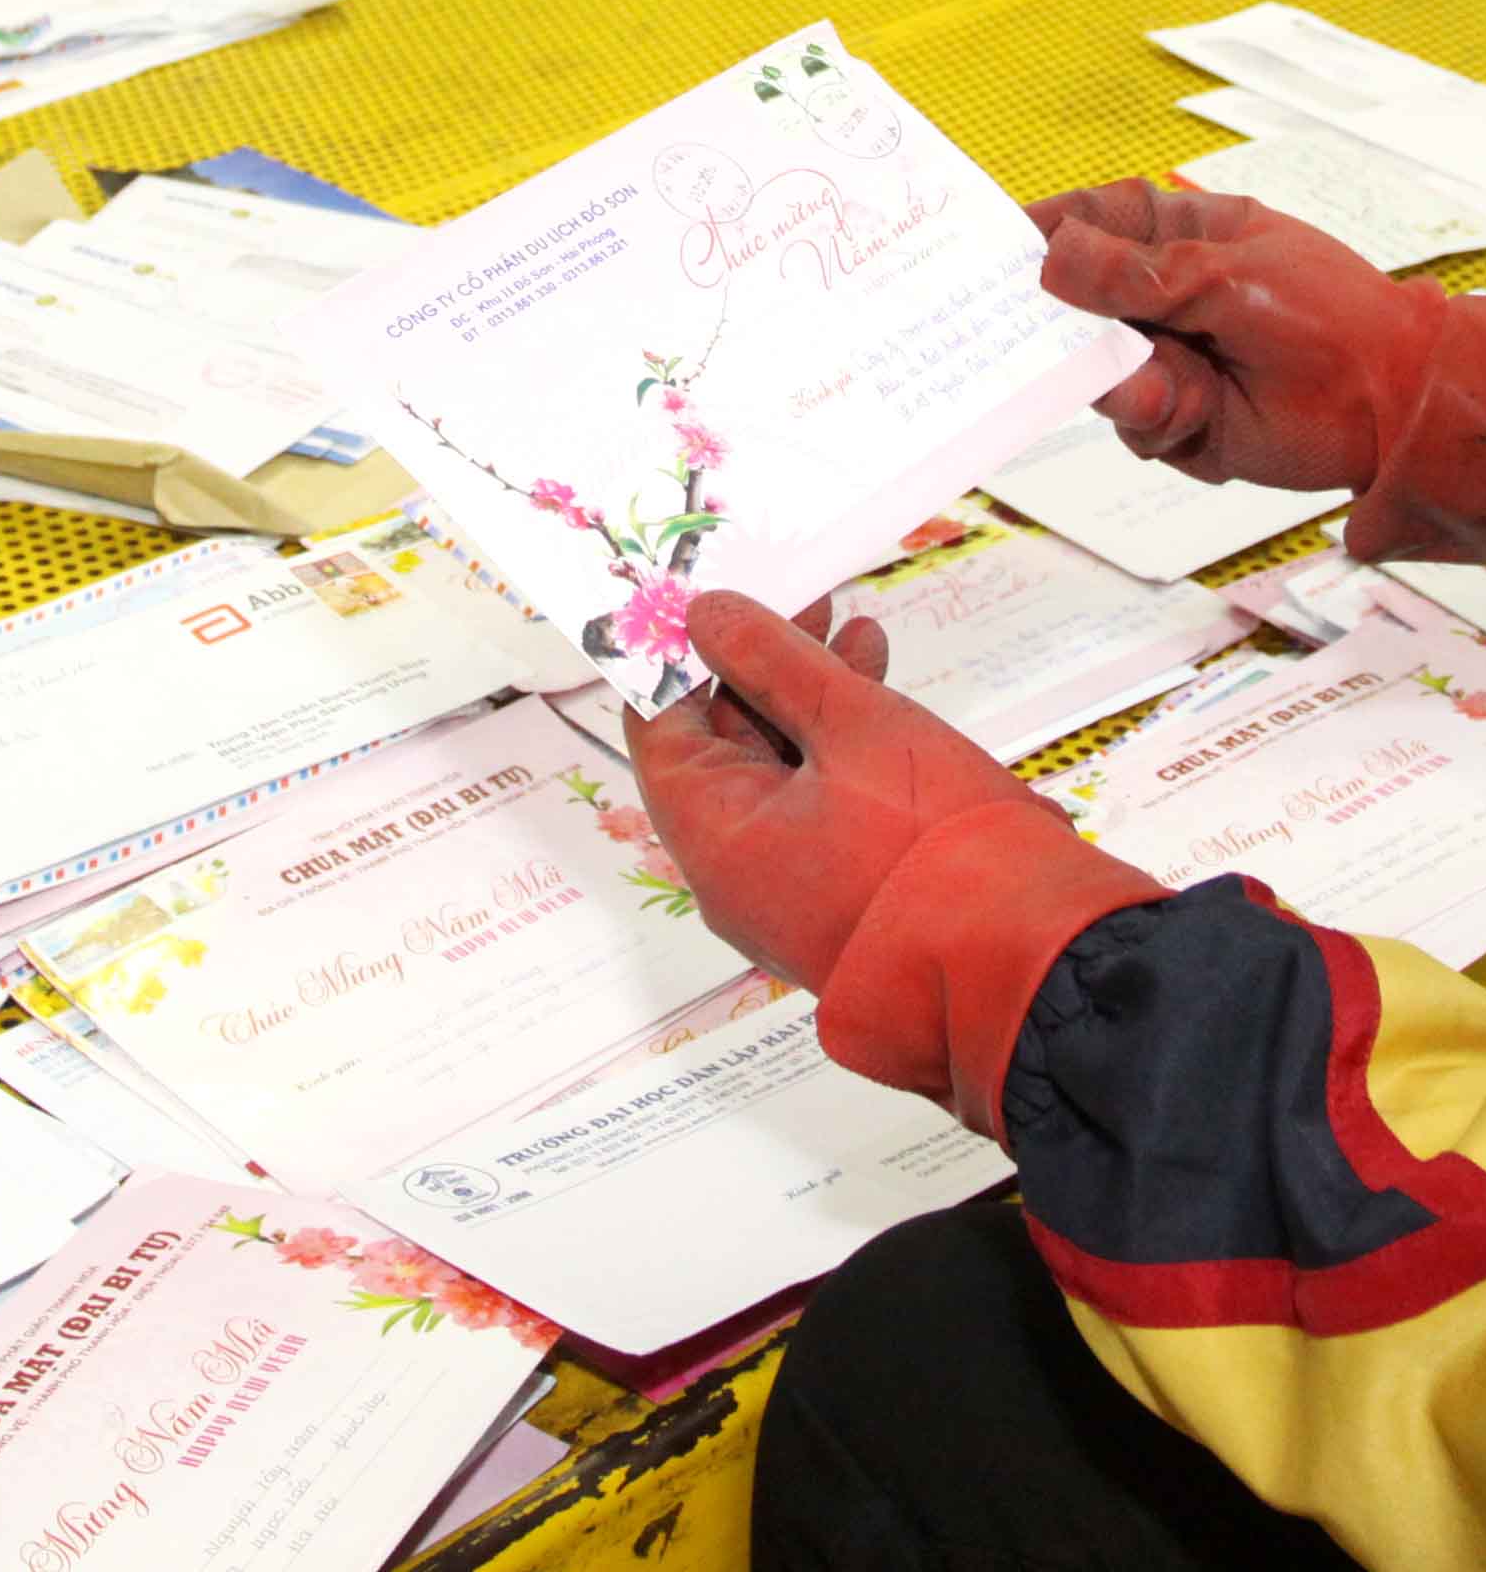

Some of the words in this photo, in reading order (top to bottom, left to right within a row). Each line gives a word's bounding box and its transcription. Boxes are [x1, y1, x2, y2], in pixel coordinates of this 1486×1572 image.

[386, 303, 438, 338] CÔNG
[436, 291, 456, 309] TY
[457, 271, 484, 296] CỔ
[525, 236, 549, 257] DU
[547, 217, 582, 244] LỊCH
[246, 583, 304, 611] Abb
[279, 848, 350, 885] CHÙA
[457, 783, 490, 807] BI
[401, 901, 491, 956] Năm
[496, 1120, 592, 1170] TRƯỜNG
[4, 1342, 66, 1397] MẬT
[57, 1292, 115, 1342] (ĐẠI
[102, 1264, 141, 1293] BI
[128, 1230, 184, 1267] TỰ)
[113, 1391, 216, 1475] Năm
[190, 1315, 277, 1386] Mới
